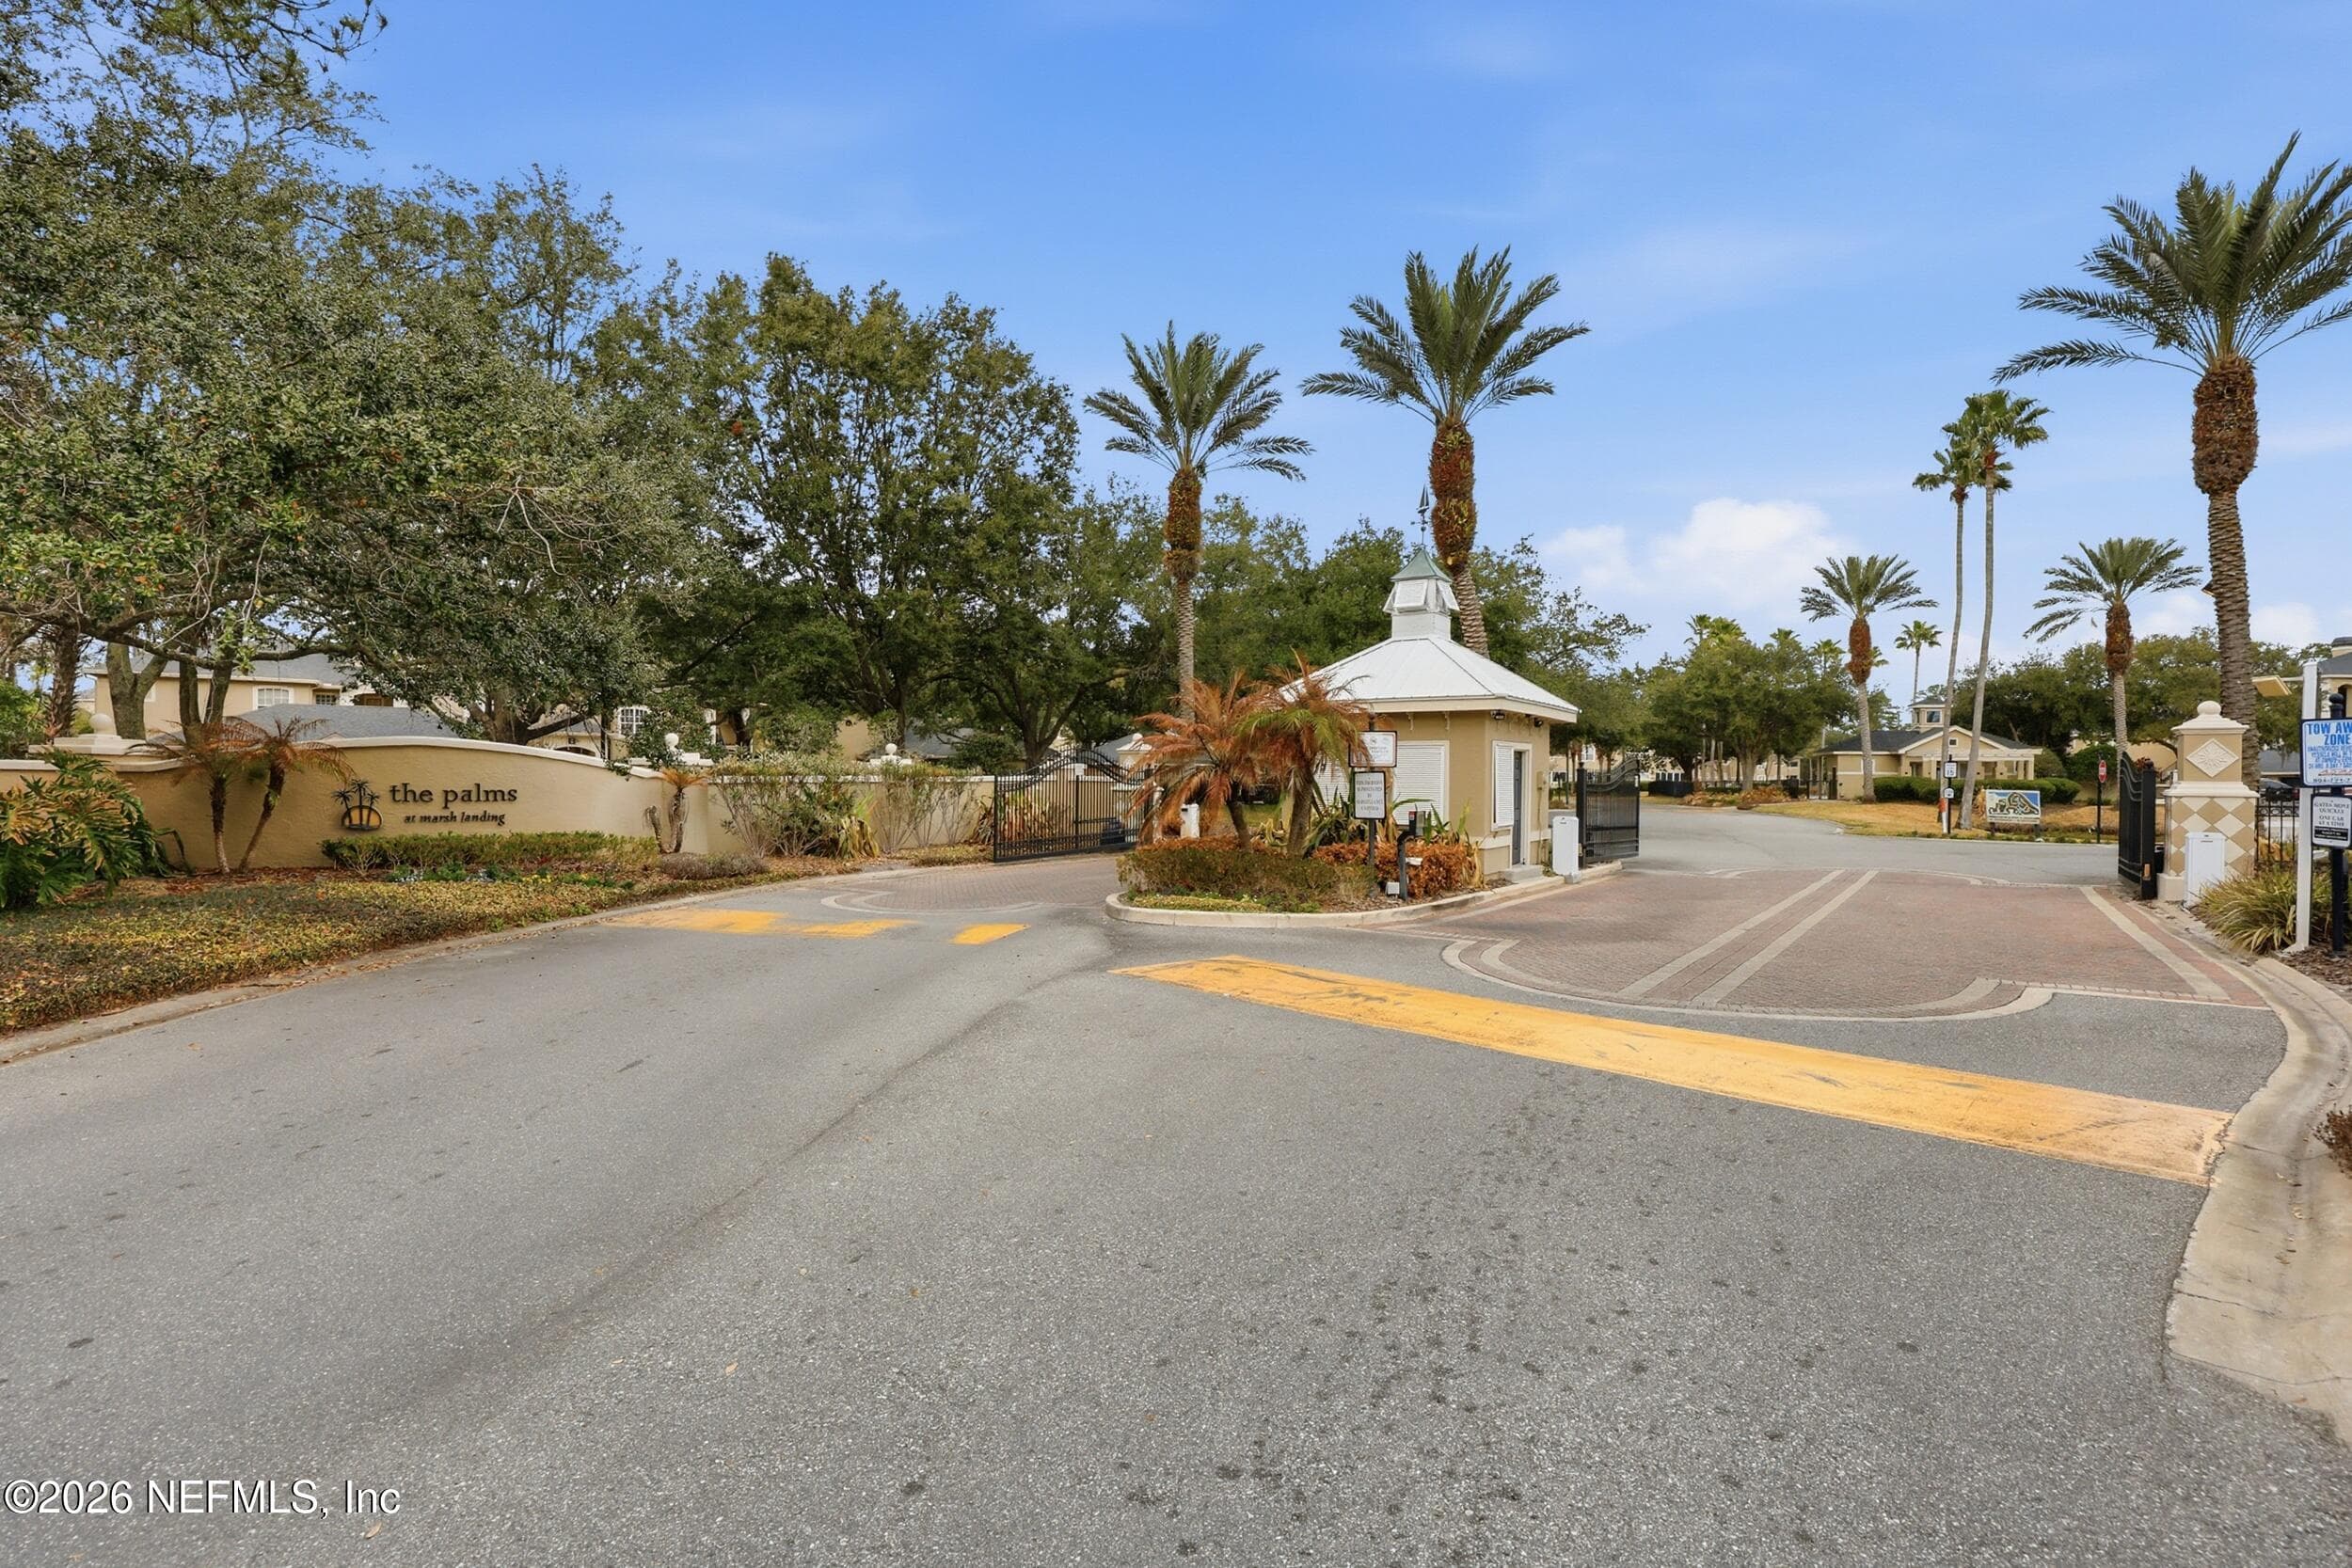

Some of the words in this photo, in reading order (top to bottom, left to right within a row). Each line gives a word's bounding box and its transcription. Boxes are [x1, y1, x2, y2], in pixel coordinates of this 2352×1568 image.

[2306, 722, 2330, 735] TOW
[2335, 721, 2352, 734] AW
[2324, 734, 2350, 746] ZONE
[389, 783, 433, 803] the
[442, 783, 517, 809] palms
[405, 815, 416, 824] at
[420, 811, 457, 824] marsh
[461, 810, 506, 826] landing
